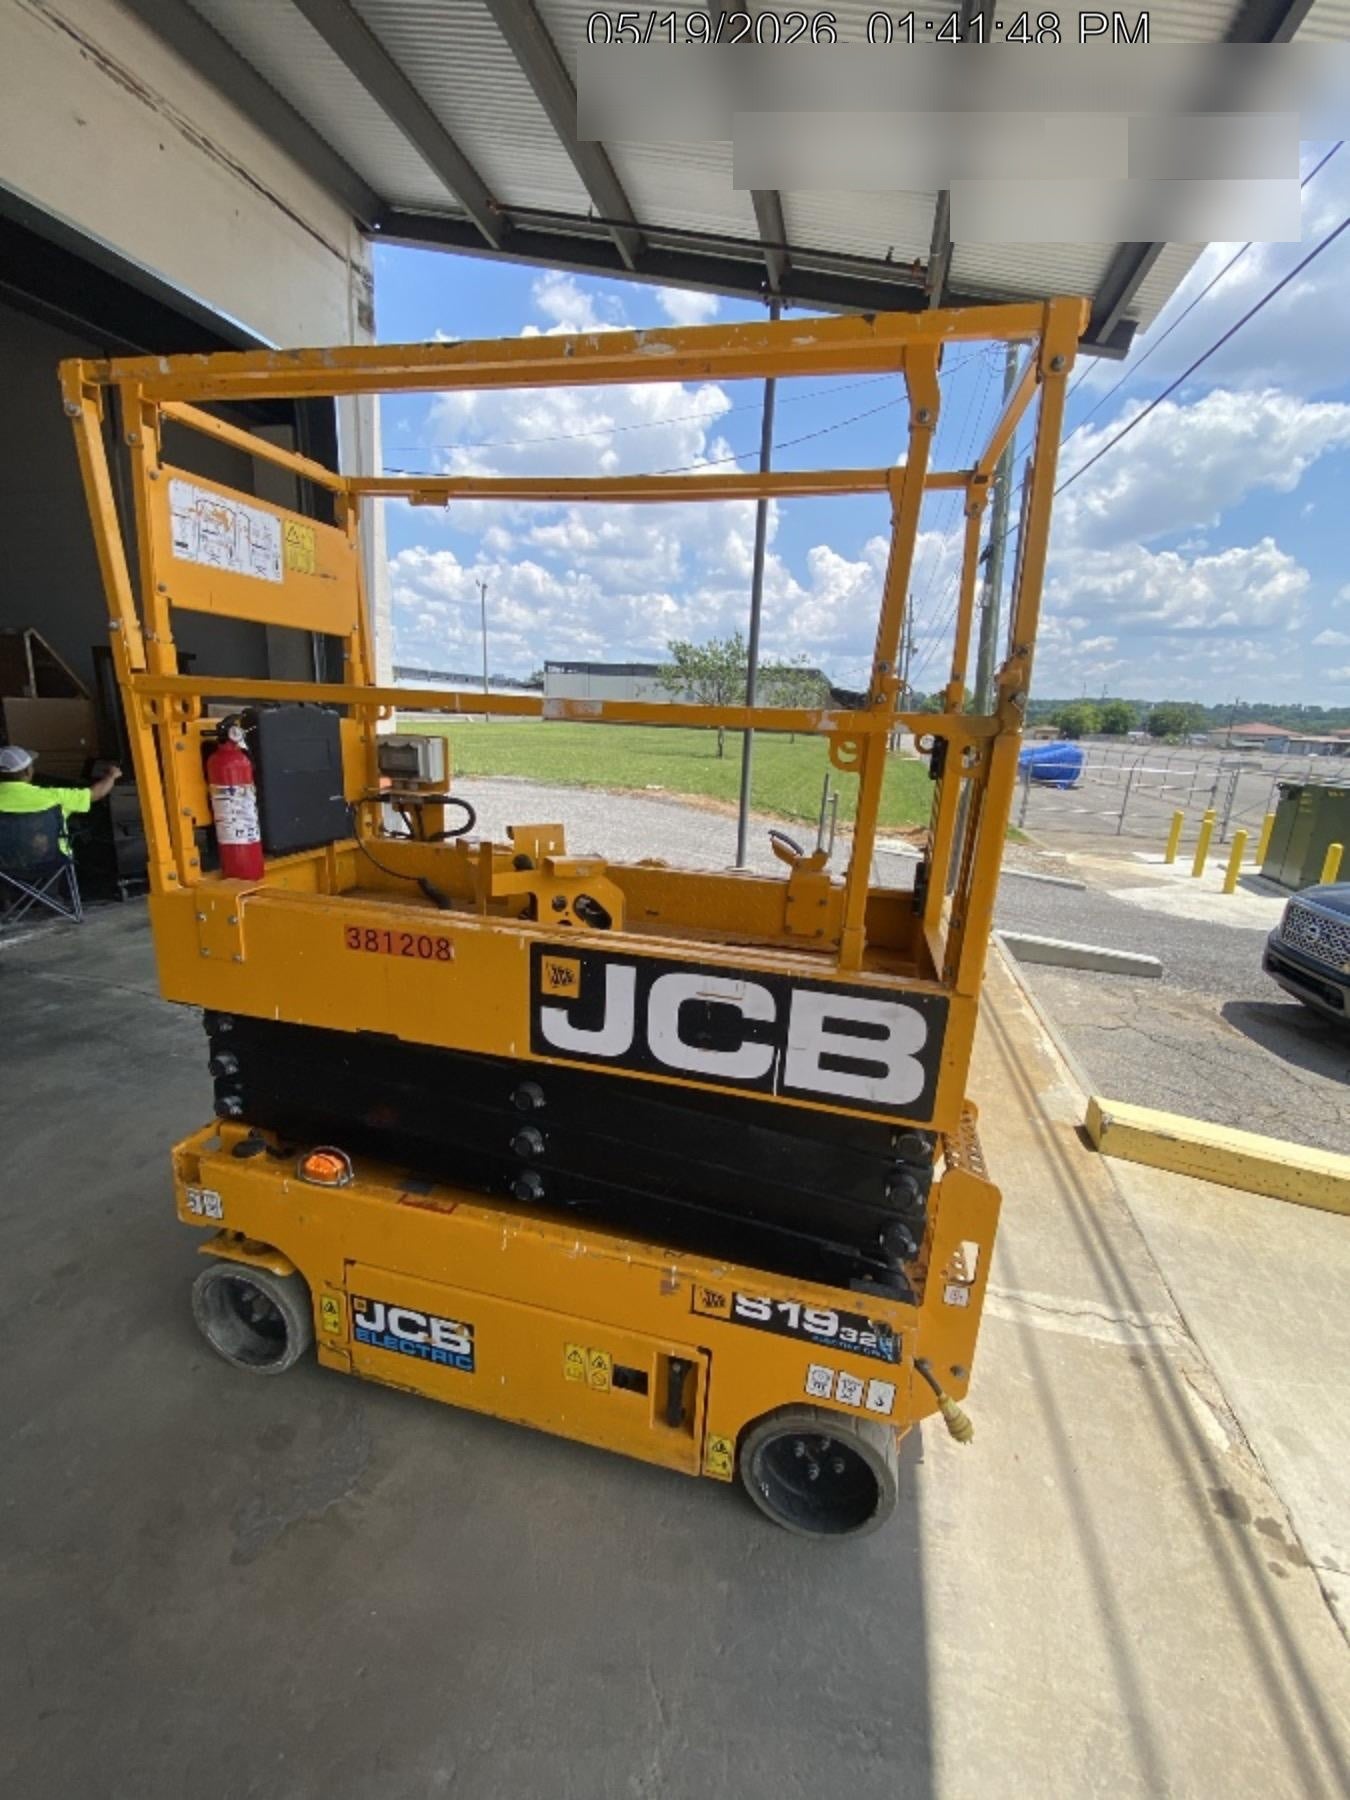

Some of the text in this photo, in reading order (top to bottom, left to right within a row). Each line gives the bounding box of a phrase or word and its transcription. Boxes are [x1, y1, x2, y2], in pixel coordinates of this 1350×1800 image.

[347, 927, 451, 961] 381208
[541, 963, 928, 1105] JCB
[355, 1302, 472, 1355] JCB
[355, 1326, 473, 1371] ELECTRIC
